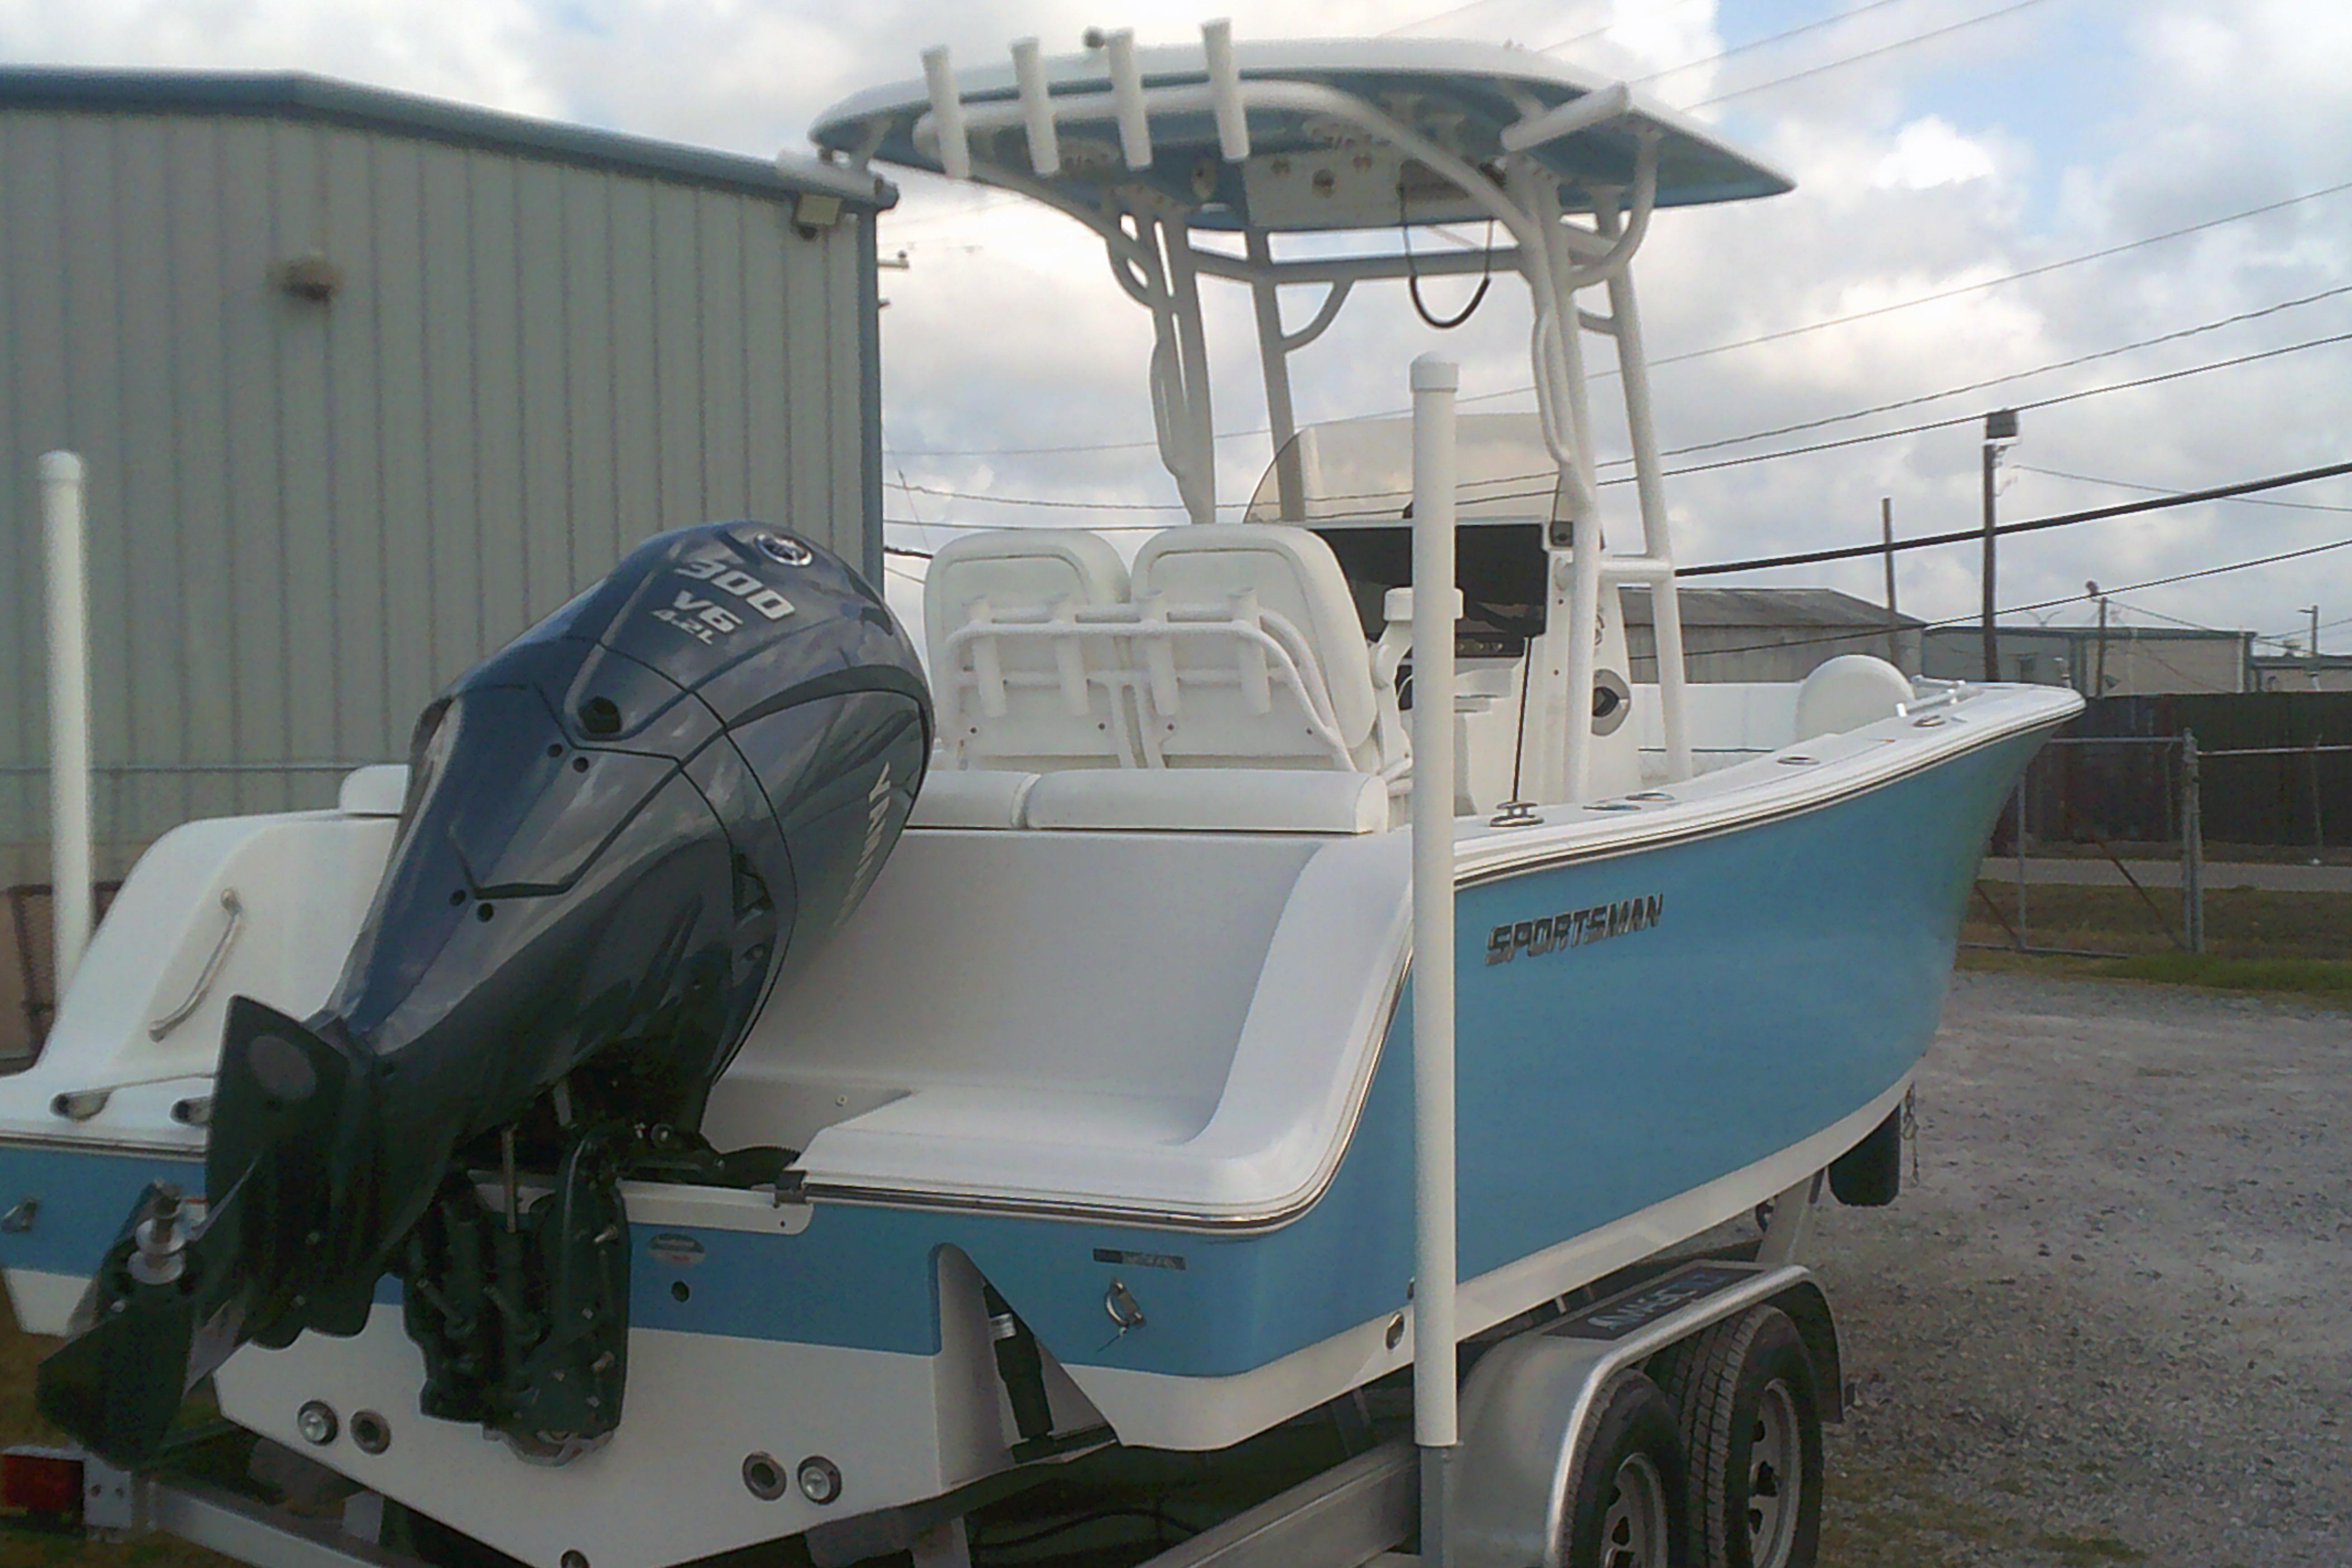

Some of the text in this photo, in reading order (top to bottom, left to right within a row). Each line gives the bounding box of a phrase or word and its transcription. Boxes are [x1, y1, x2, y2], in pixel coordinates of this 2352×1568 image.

[673, 590, 744, 633] V6
[674, 558, 796, 620] 300
[651, 608, 713, 645] 4.2L
[835, 761, 891, 926] YAMA
[1485, 892, 1663, 966] SPORTSMAN
